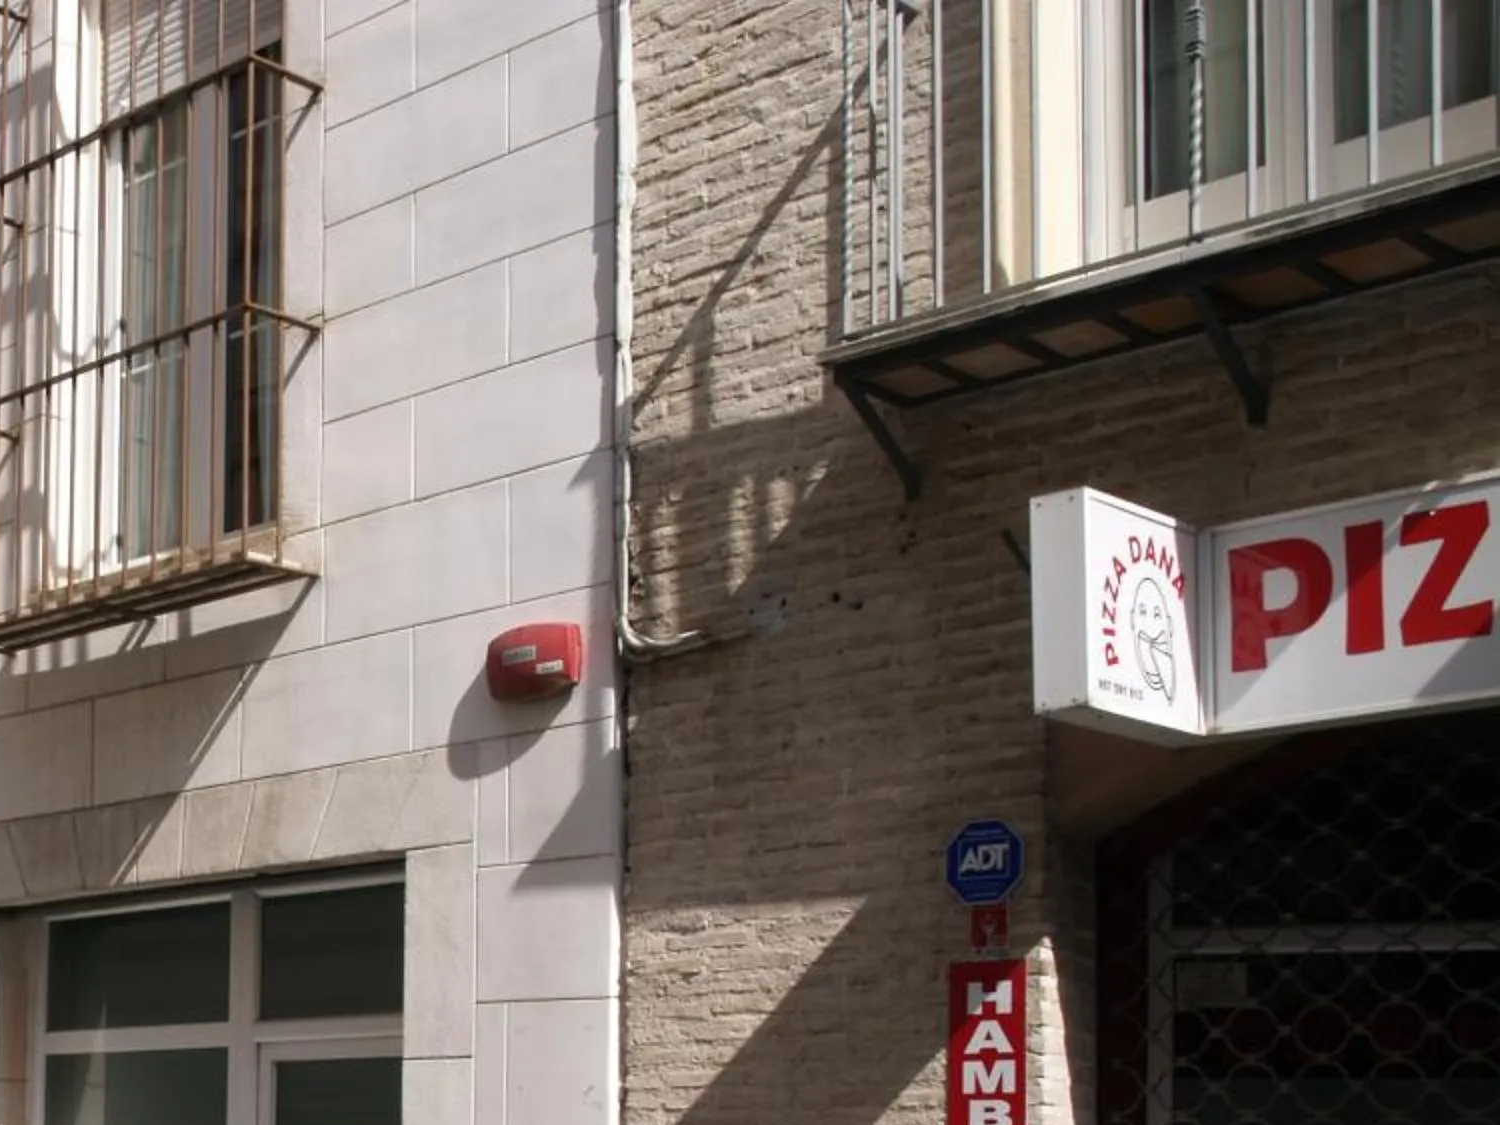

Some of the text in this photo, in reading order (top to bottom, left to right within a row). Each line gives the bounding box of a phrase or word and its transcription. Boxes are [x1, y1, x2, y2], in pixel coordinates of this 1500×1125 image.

[1102, 555, 1127, 667] PIZZA
[1127, 534, 1187, 600] DANA
[1228, 498, 1495, 674] PIZ
[960, 843, 1009, 873] ADT
